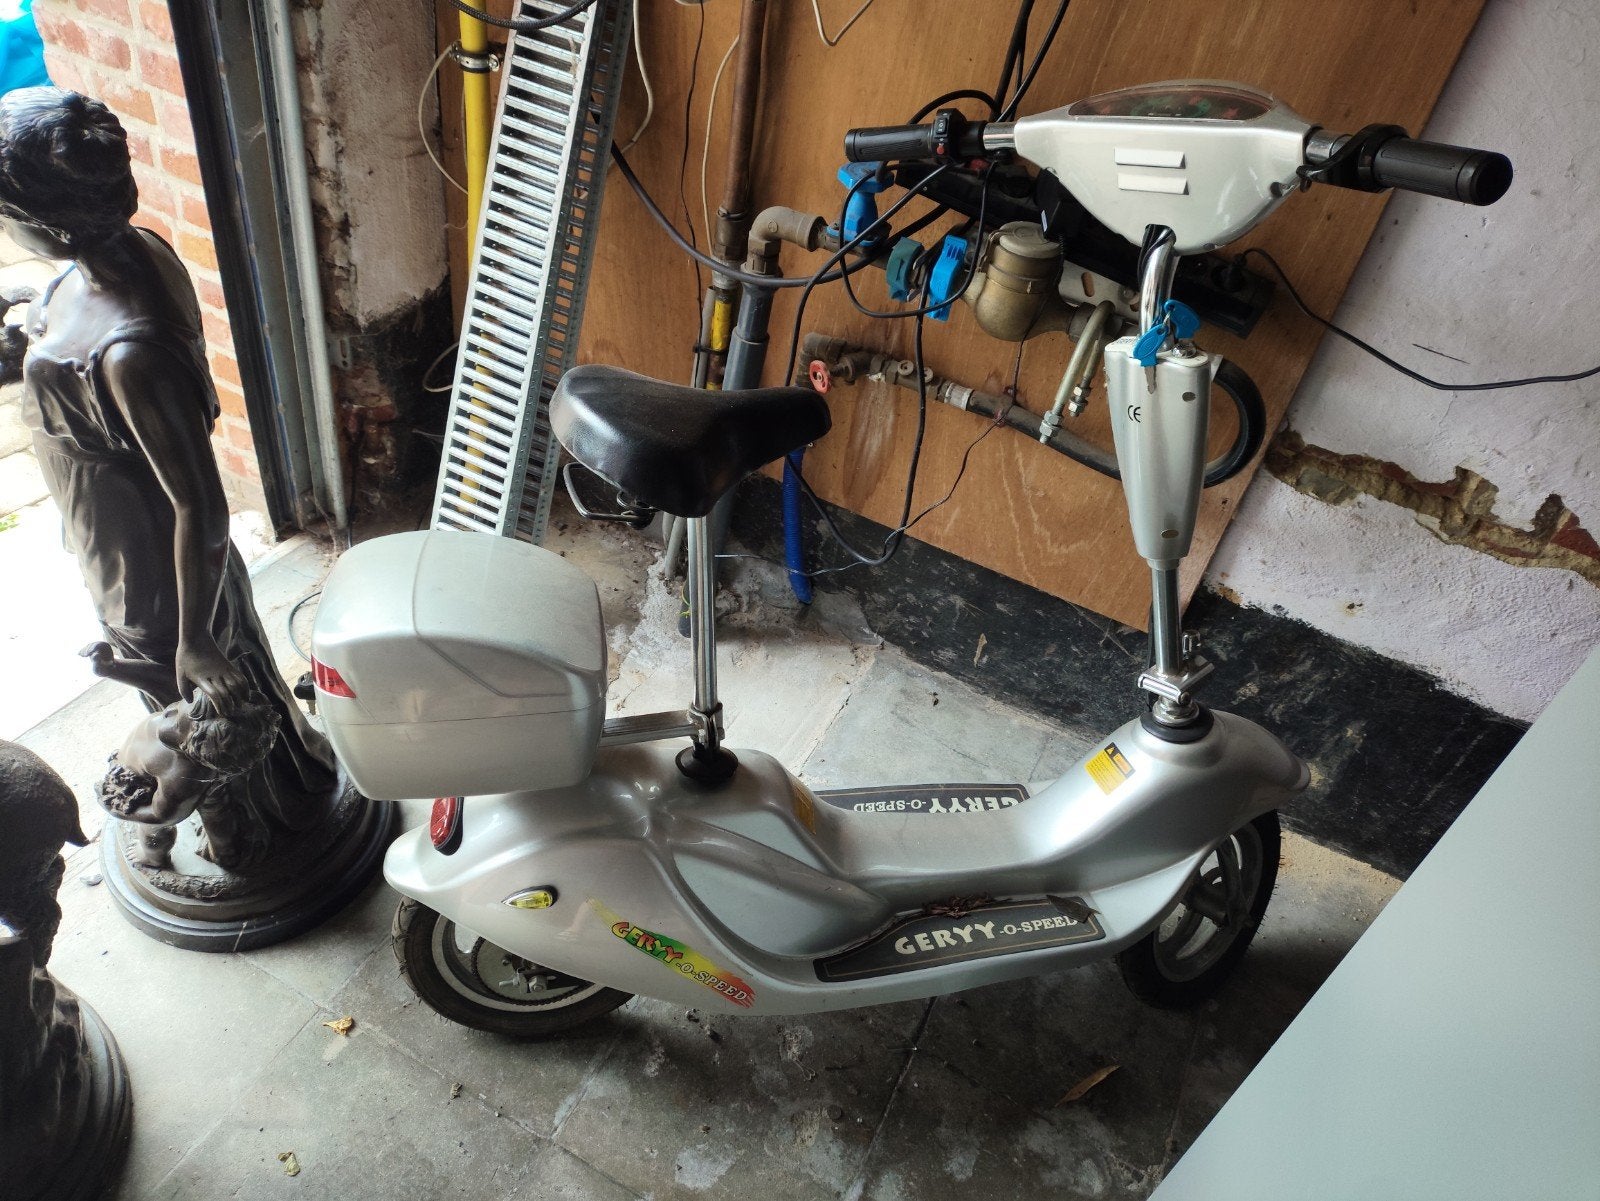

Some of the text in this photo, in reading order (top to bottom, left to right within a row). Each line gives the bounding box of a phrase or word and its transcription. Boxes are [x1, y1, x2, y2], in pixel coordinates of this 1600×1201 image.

[1127, 404, 1142, 424] CE
[611, 921, 684, 964] GERYY
[894, 920, 995, 955] GERYY
